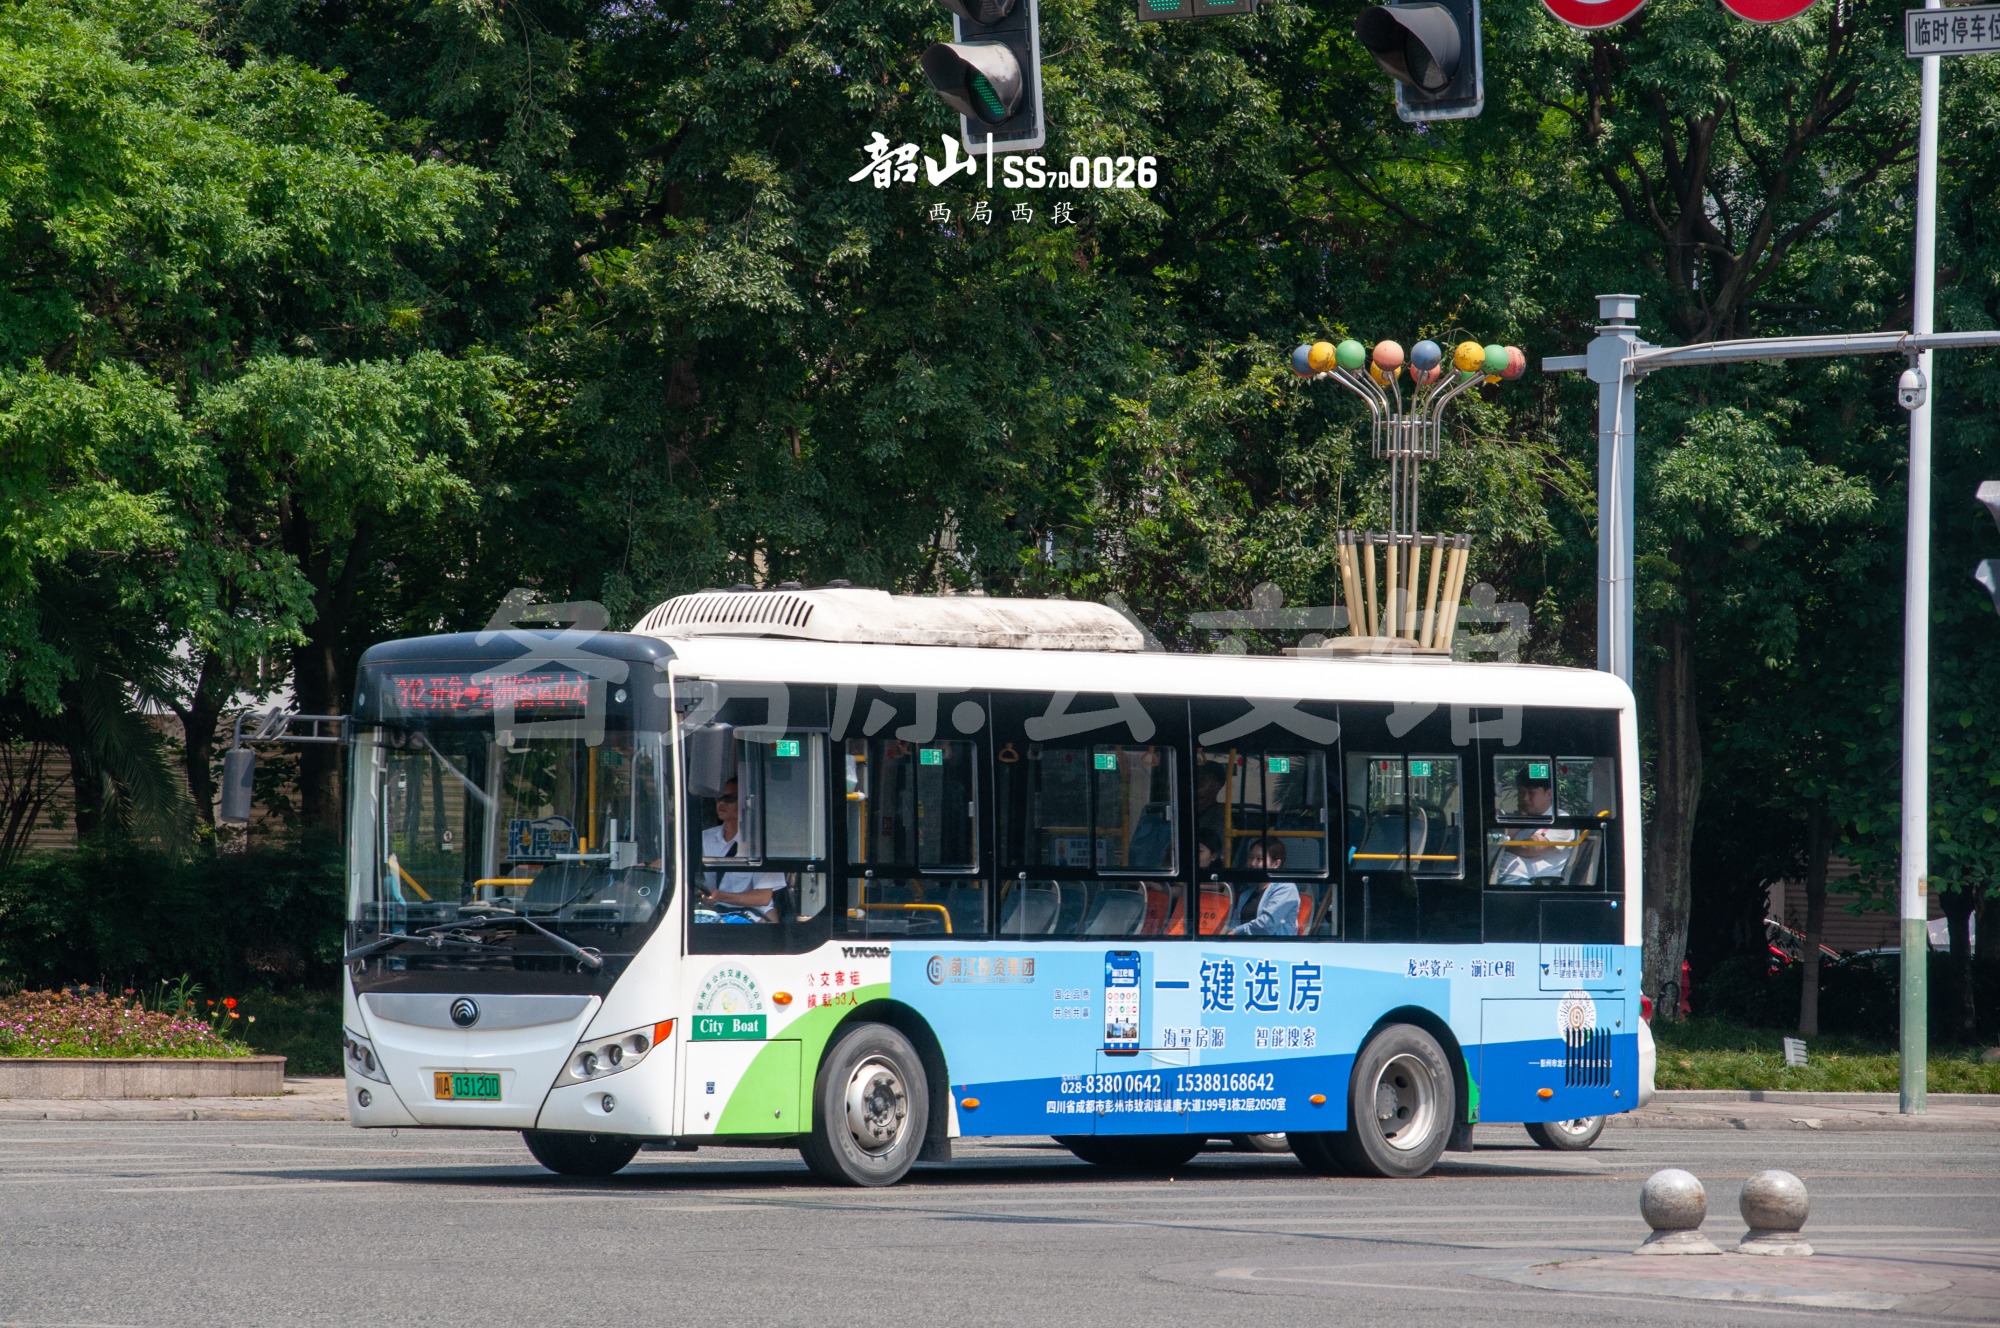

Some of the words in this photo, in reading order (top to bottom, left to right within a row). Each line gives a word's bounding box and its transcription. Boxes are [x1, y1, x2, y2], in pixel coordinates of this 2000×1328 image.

[841, 946, 891, 958] YUTONG
[807, 971, 861, 986] 公交客运
[1155, 959, 1322, 1012] 一键选房
[700, 1019, 724, 1036] City
[732, 1018, 759, 1032] Boat
[1163, 1028, 1225, 1048] 海量房源
[1256, 1028, 1316, 1048] 智能搜索
[1176, 1072, 1275, 1092] 15388168642
